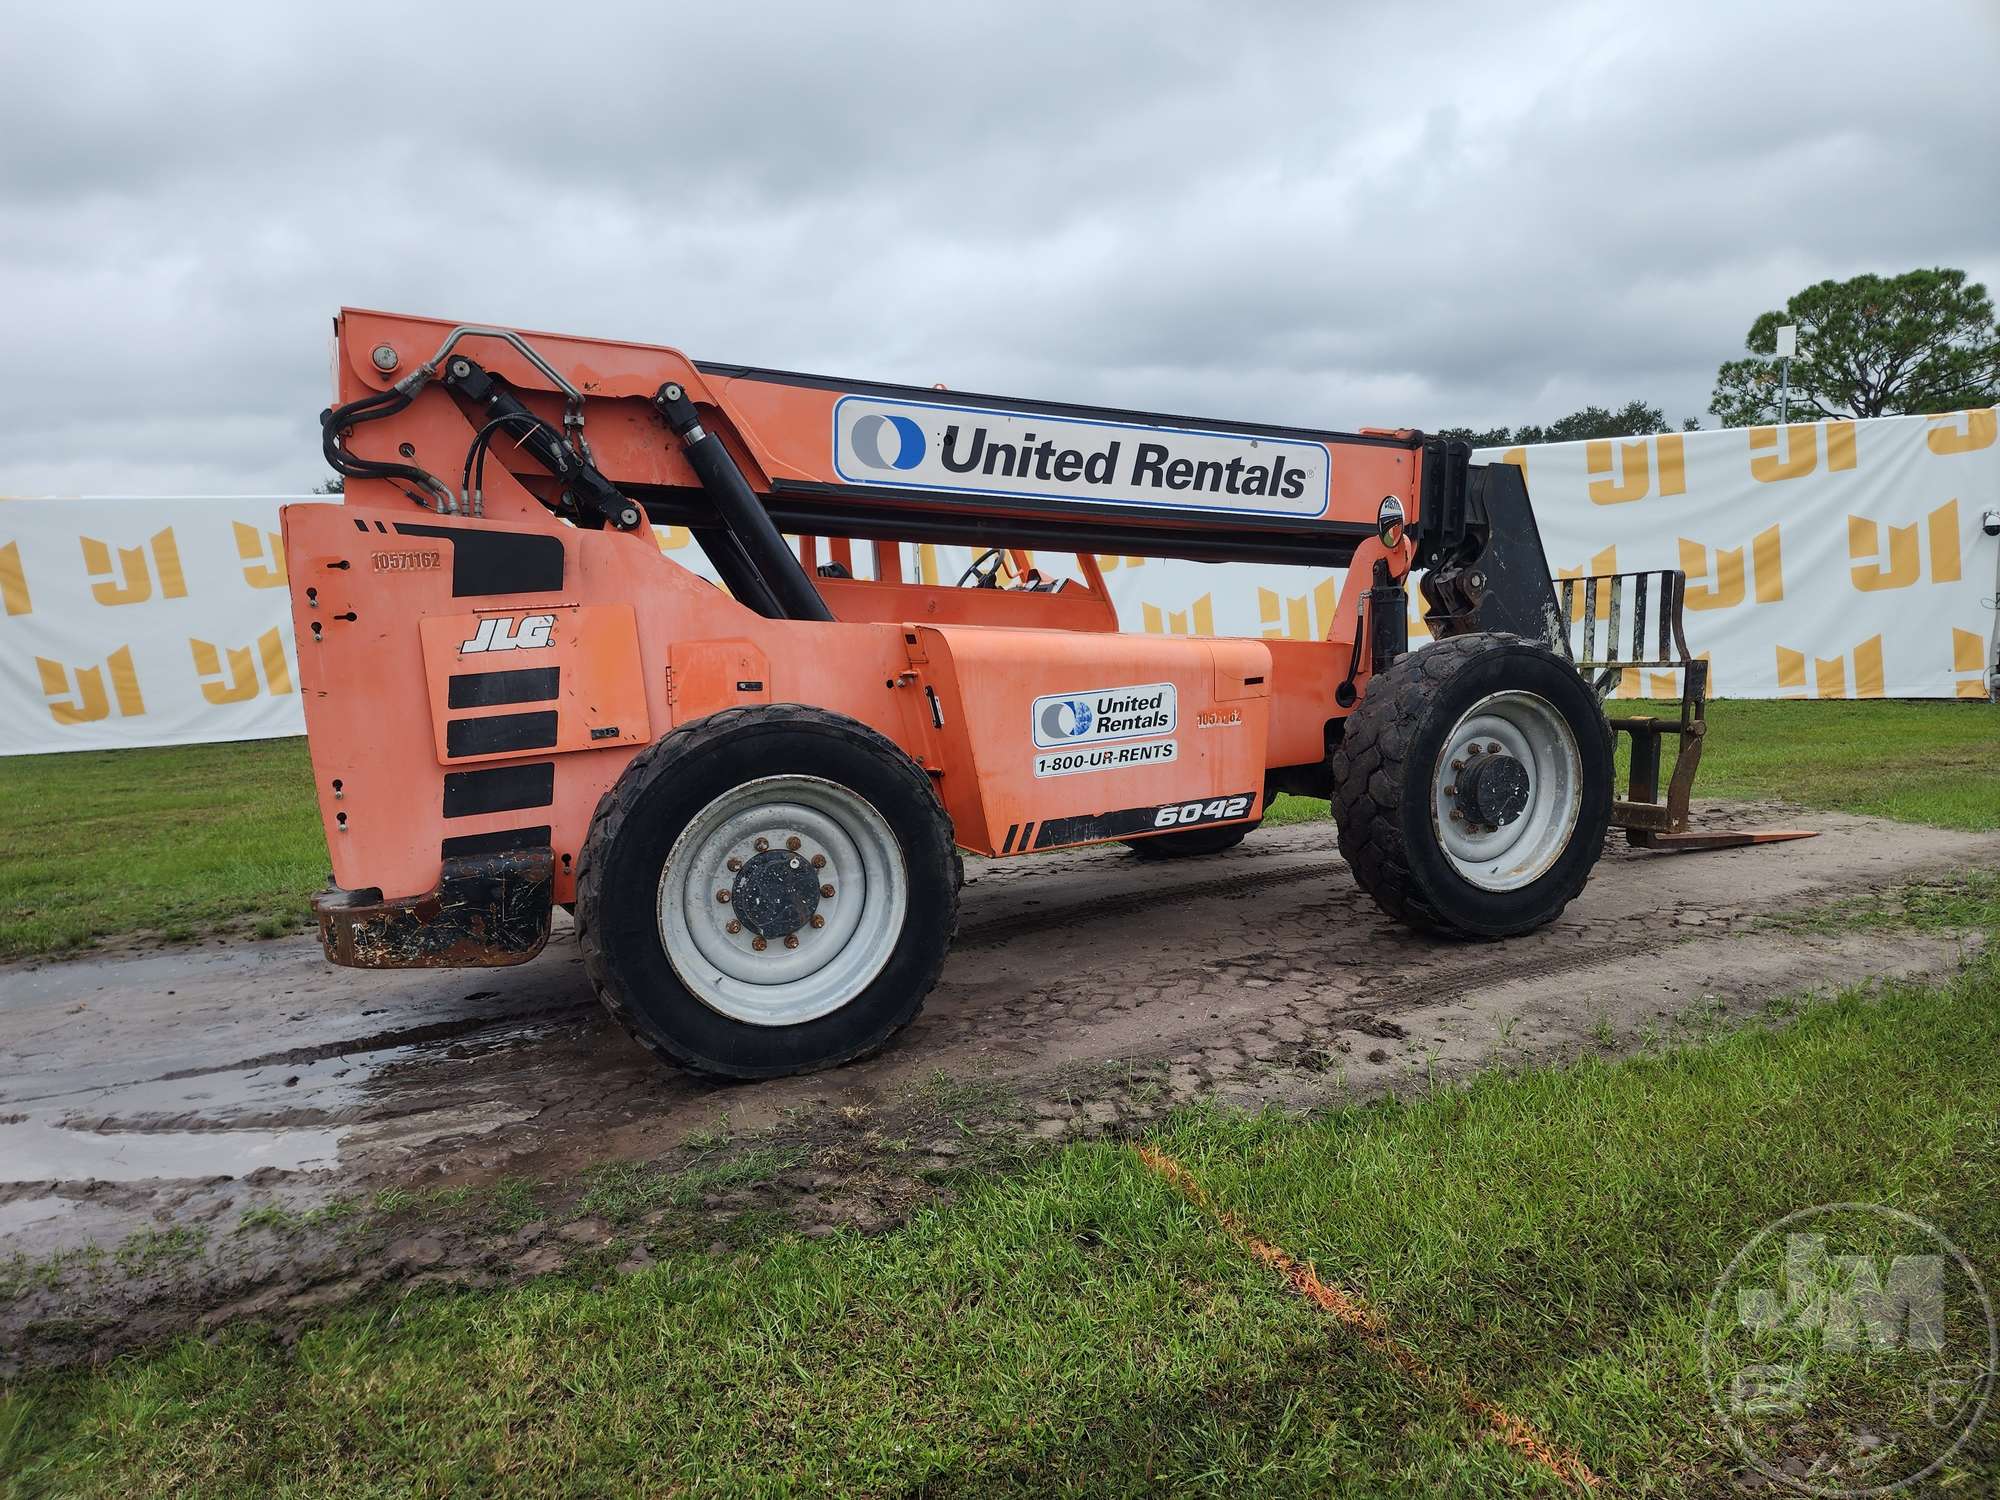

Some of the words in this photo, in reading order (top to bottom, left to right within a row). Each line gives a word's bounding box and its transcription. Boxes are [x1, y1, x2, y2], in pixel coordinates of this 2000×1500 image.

[941, 425, 1121, 483] United
[1131, 443, 1306, 499] Rentals
[372, 551, 440, 570] 10571162
[460, 615, 556, 654] JLG
[1096, 692, 1162, 715] United
[1096, 711, 1169, 733] Rentals
[1039, 743, 1173, 773] 1-800-UR-RENTS
[1154, 797, 1248, 828] 6042
